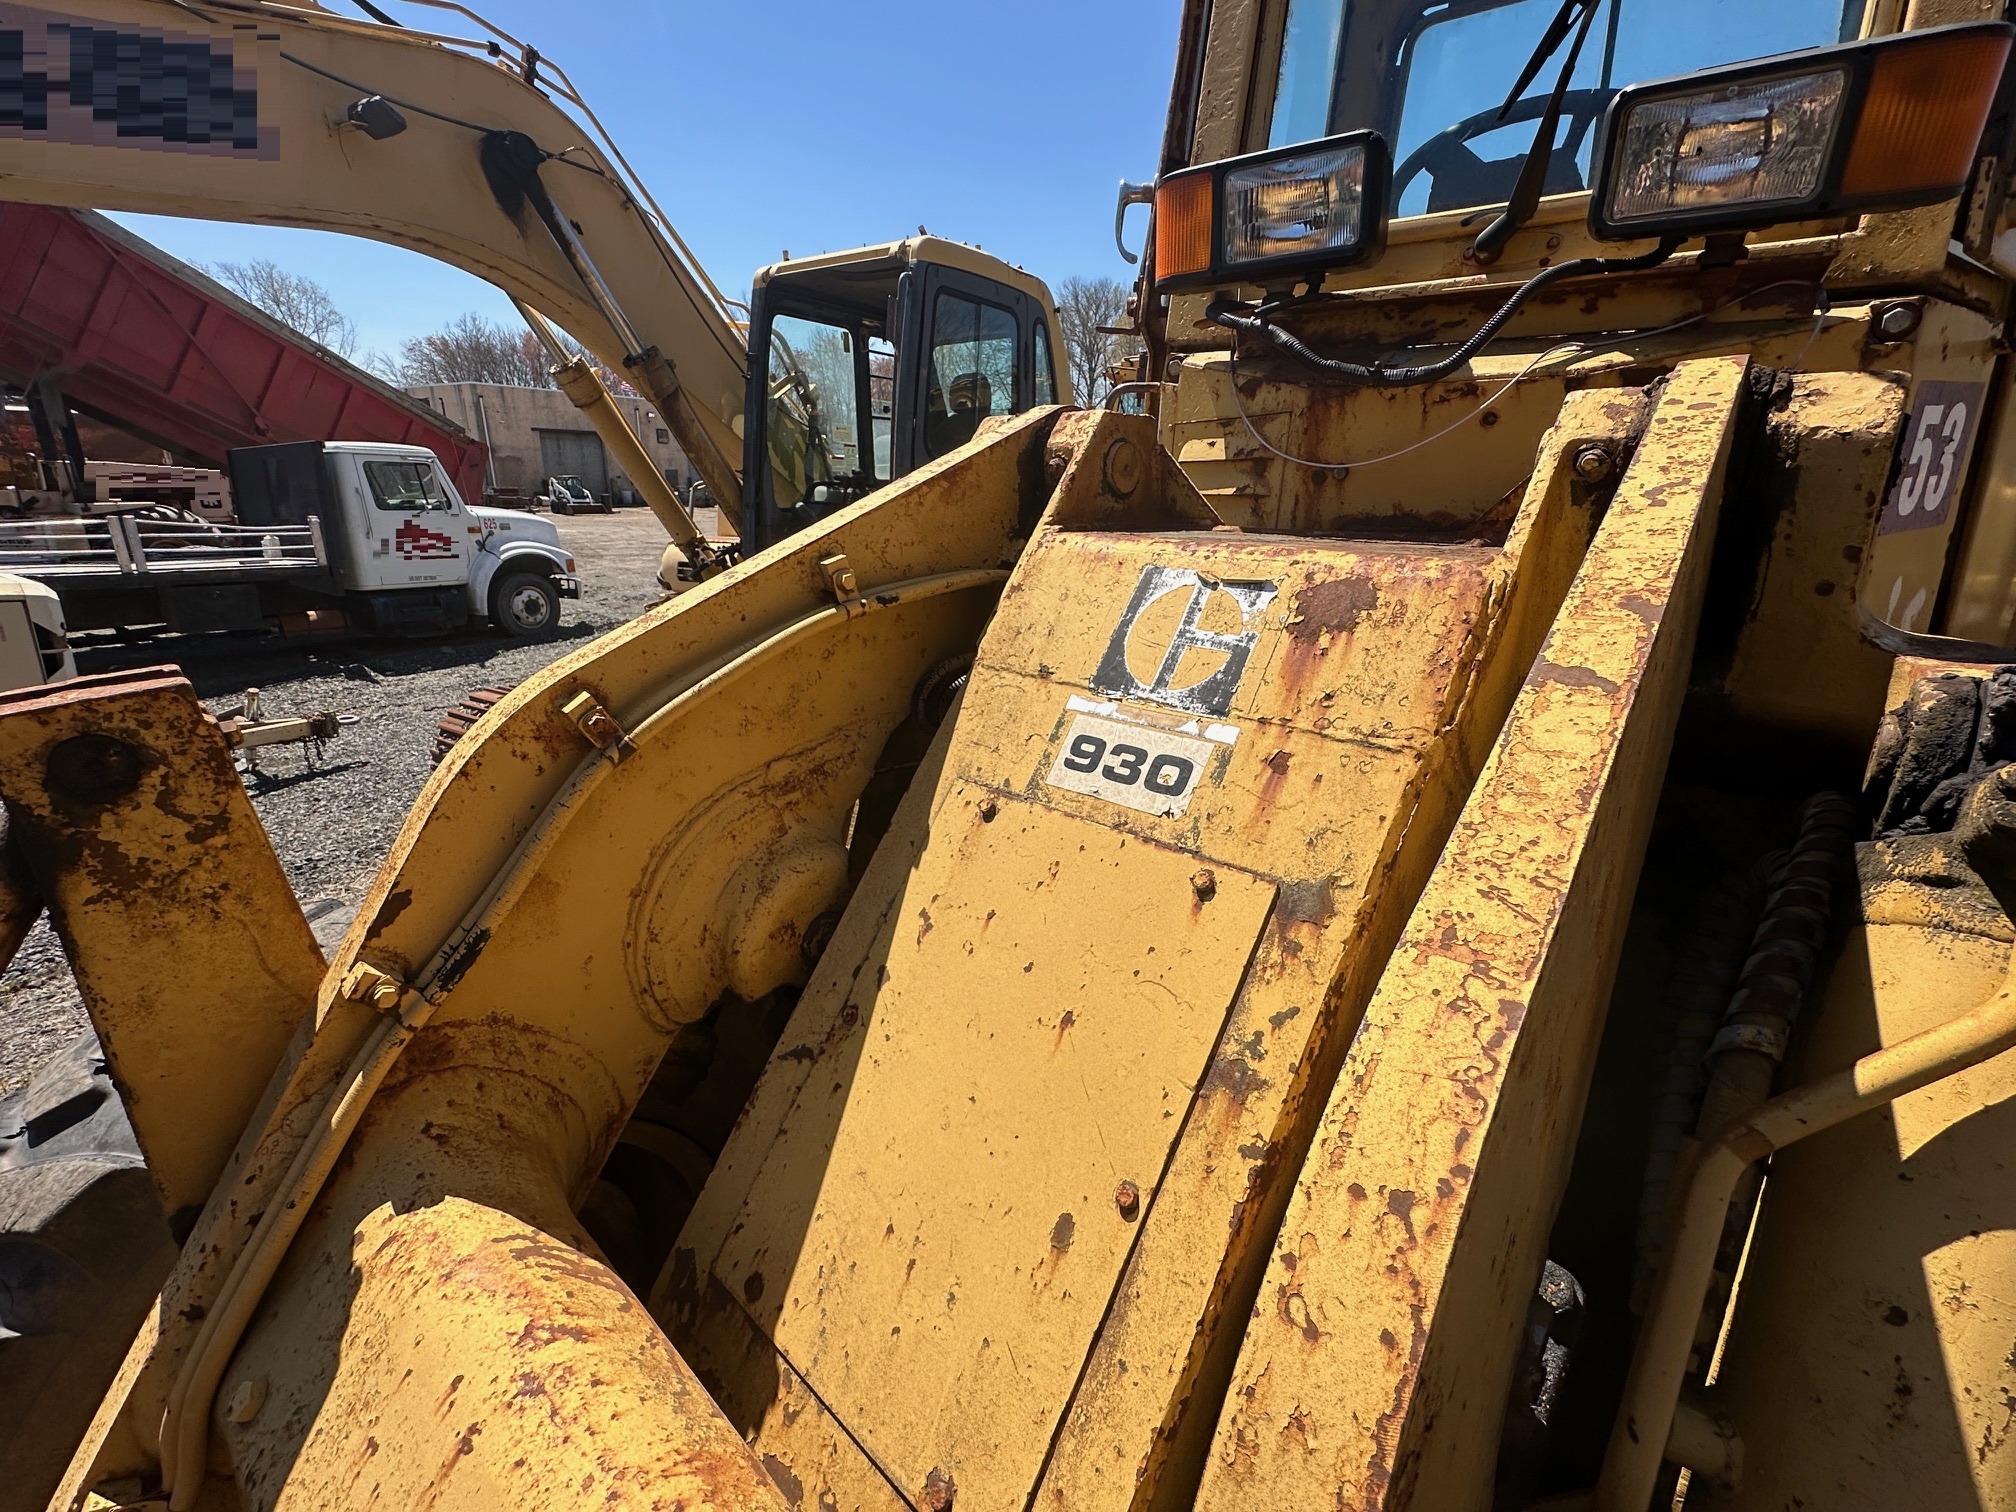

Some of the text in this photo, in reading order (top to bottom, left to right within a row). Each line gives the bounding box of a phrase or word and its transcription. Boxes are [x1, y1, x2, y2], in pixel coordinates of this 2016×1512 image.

[1898, 401, 1967, 516] 53
[483, 518, 497, 529] 625
[1063, 734, 1194, 797] 930
